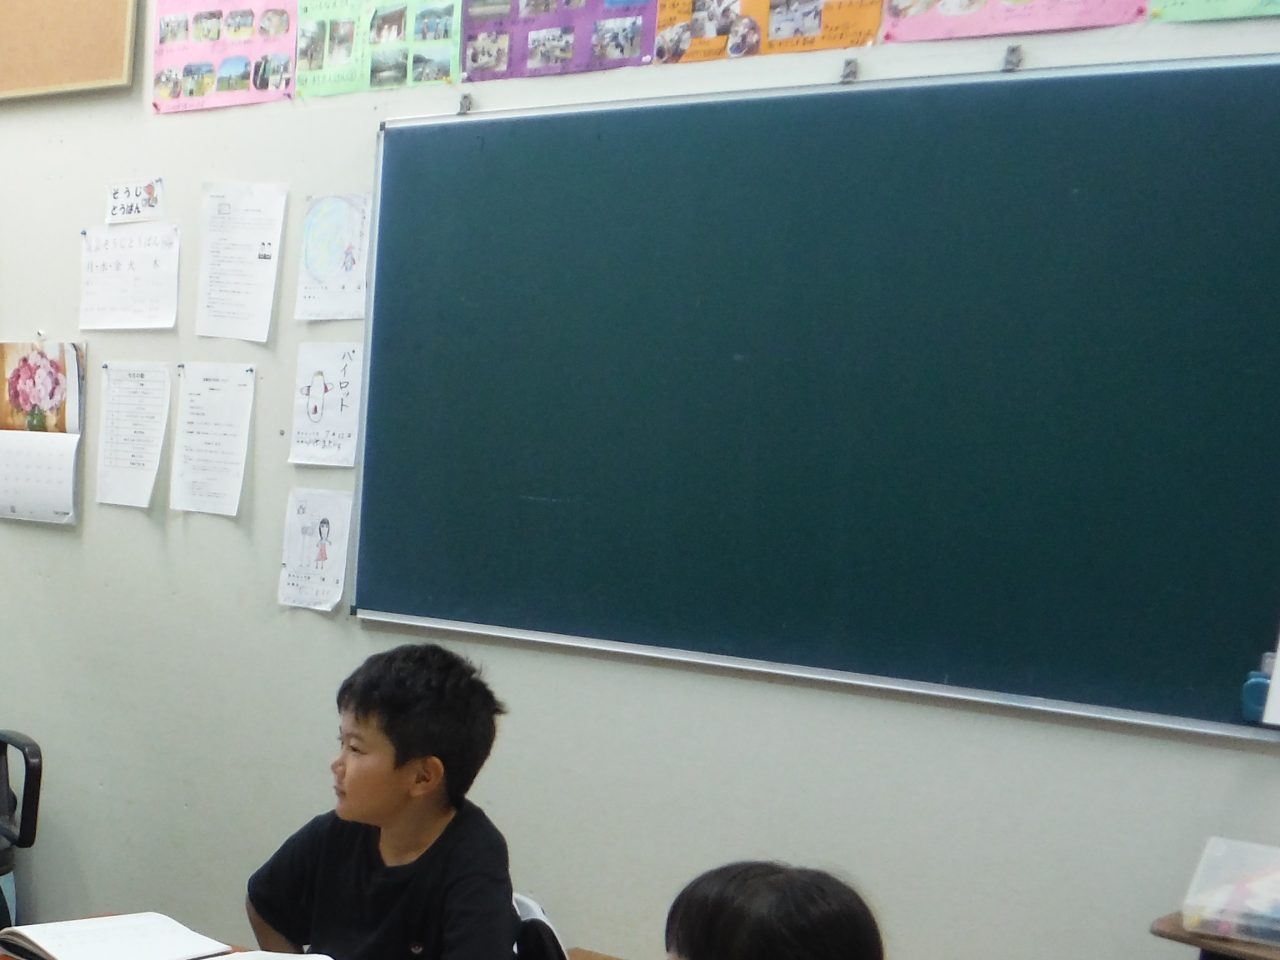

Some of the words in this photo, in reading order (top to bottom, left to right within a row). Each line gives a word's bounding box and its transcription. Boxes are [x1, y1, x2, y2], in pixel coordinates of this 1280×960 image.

[112, 186, 142, 200] そうじ
[111, 203, 141, 216] とうばん
[339, 349, 355, 412] パイロット
